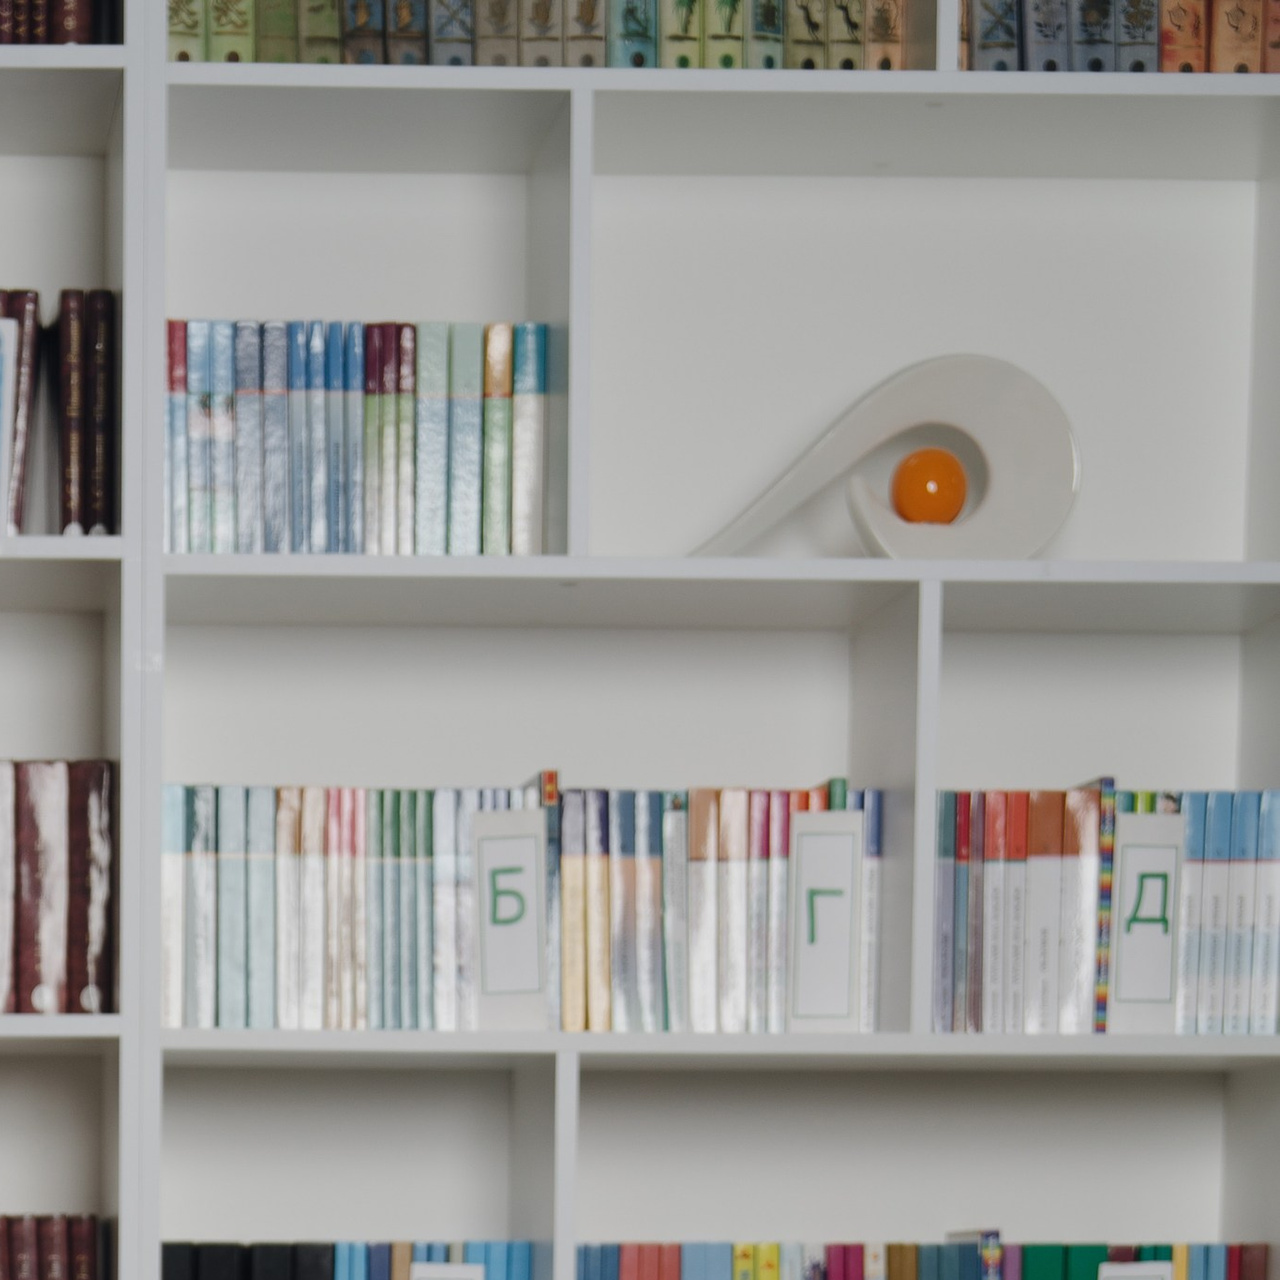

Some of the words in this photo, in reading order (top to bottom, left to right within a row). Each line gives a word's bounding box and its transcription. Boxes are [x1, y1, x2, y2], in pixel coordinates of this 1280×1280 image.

[489, 865, 526, 926] Б
[807, 888, 845, 946] Г
[1125, 872, 1170, 935] Д
